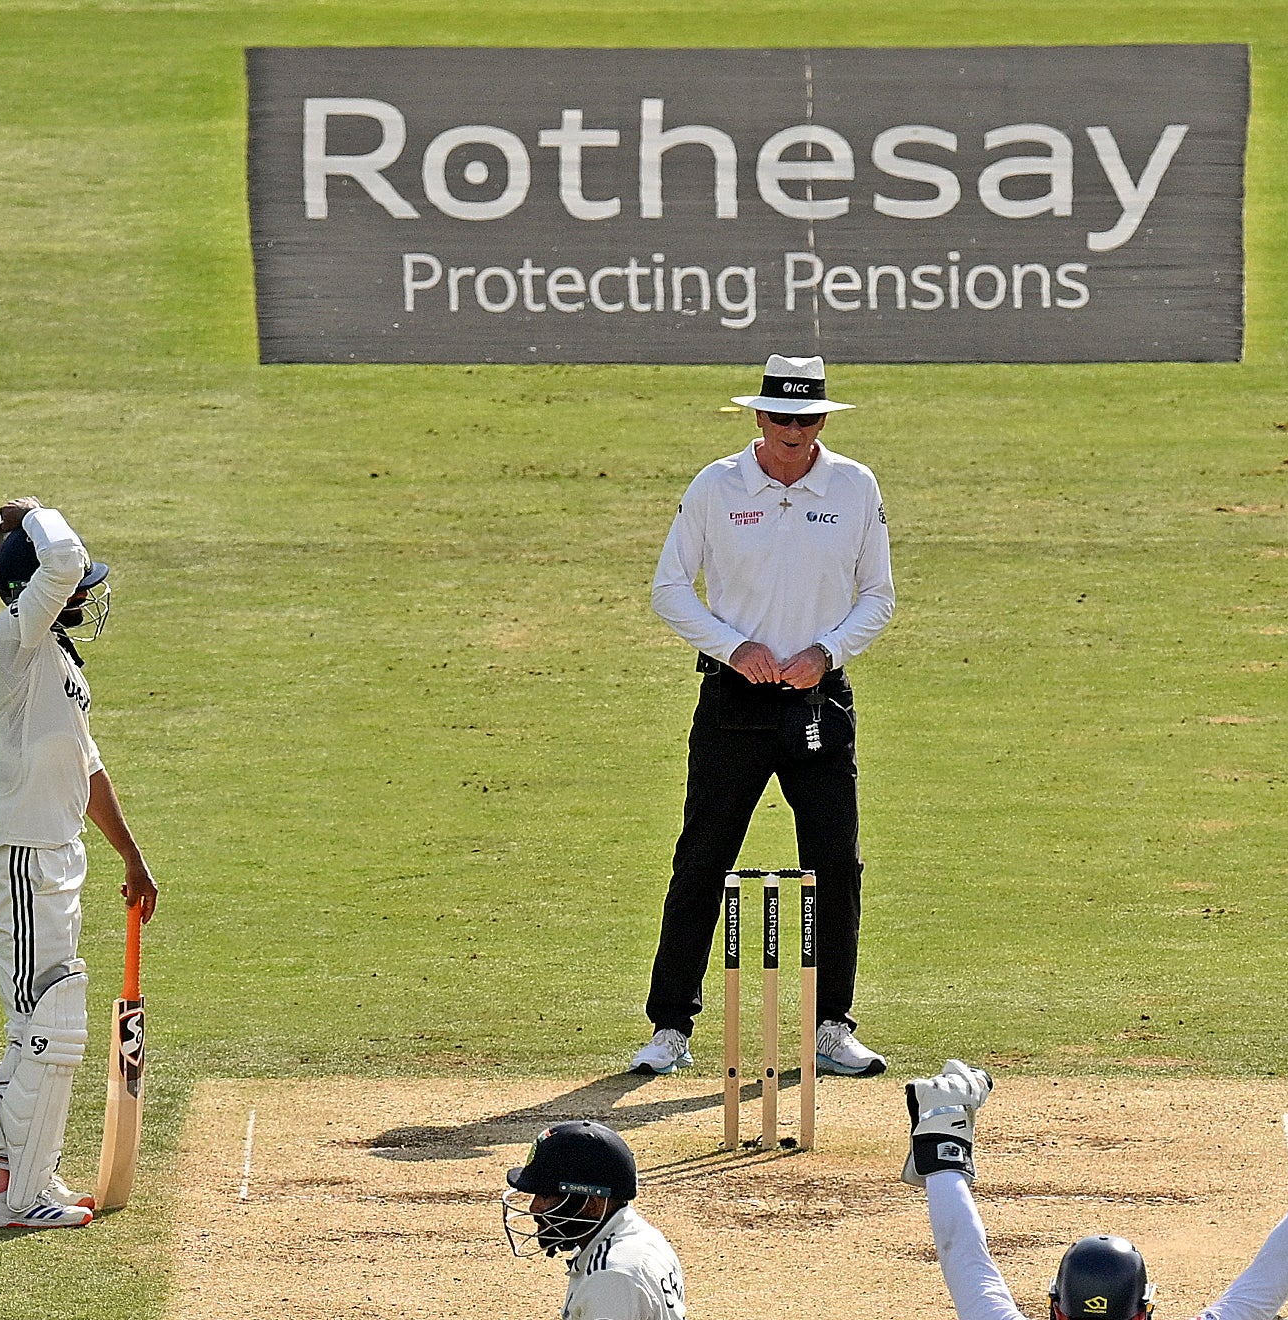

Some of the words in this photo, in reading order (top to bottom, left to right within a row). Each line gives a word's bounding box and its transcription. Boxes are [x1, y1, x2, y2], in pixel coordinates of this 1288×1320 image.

[303, 97, 1189, 252] Rothesay
[403, 252, 758, 328] Protecting
[785, 251, 1090, 310] Pensions
[793, 383, 810, 393] ICC
[729, 510, 764, 520] Emirates
[819, 513, 839, 523] ICC
[728, 897, 738, 958] Rothesay
[767, 897, 778, 958] Rothesay
[803, 896, 813, 956] Rothesay
